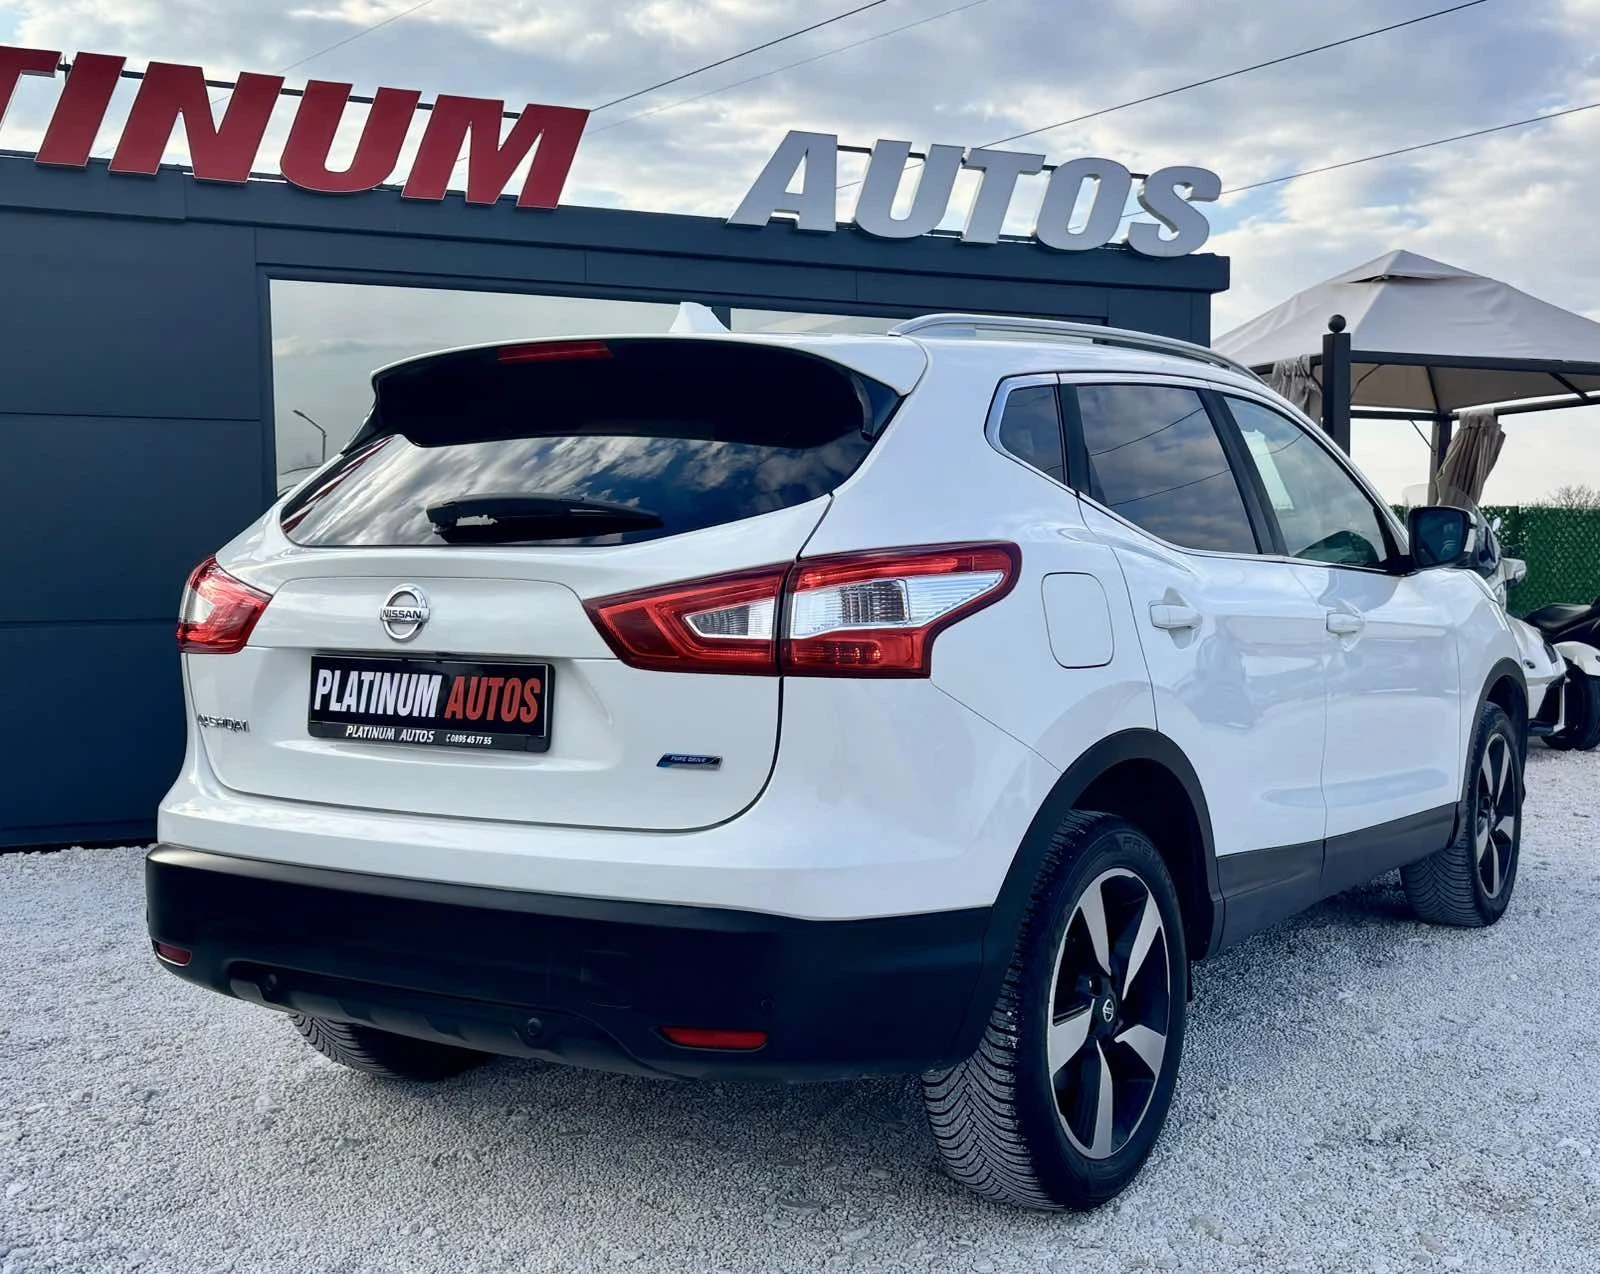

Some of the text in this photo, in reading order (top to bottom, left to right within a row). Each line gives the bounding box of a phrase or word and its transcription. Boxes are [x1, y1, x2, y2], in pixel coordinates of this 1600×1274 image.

[726, 130, 1223, 258] AUTOS
[382, 609, 422, 619] NISSAN
[313, 669, 541, 724] PLATINUM AUTOS
[345, 725, 396, 740] PLATINUM
[398, 728, 436, 743] AUTOS
